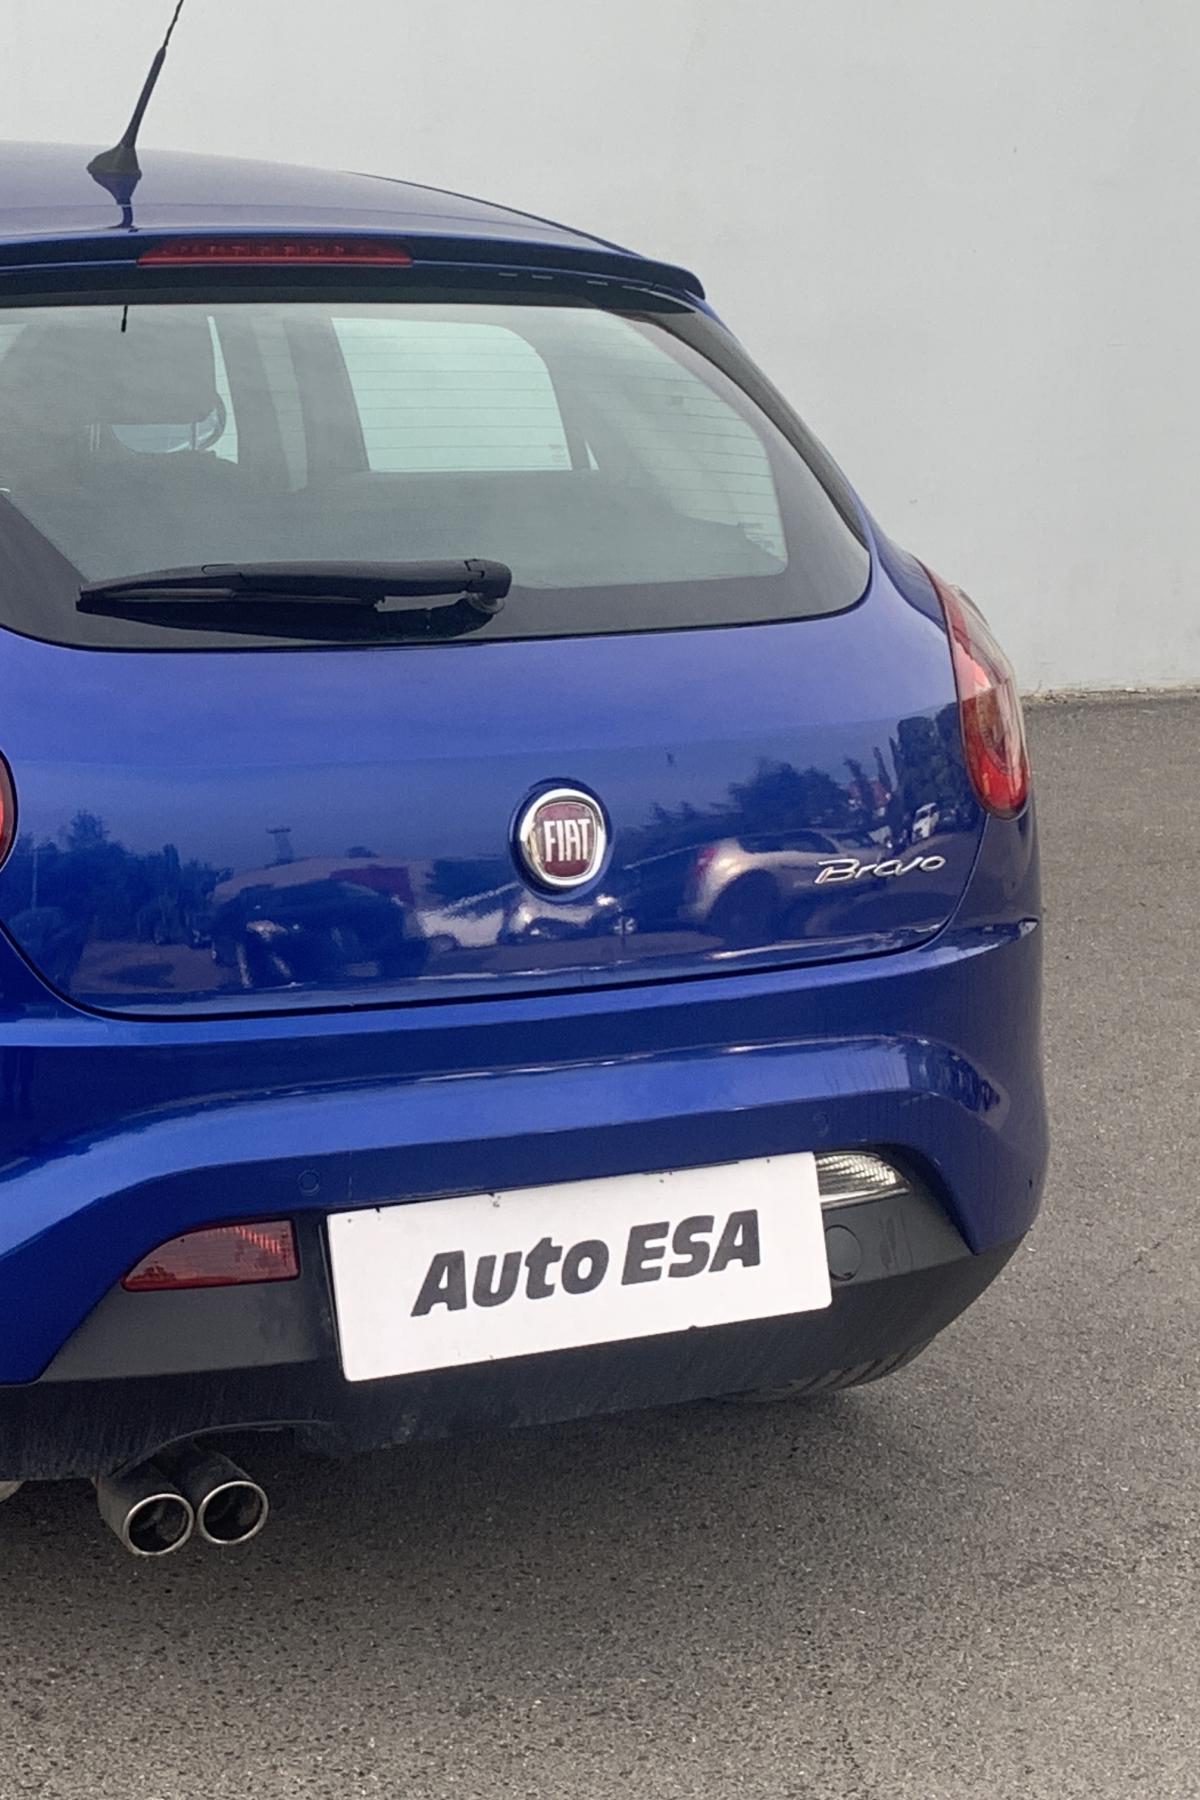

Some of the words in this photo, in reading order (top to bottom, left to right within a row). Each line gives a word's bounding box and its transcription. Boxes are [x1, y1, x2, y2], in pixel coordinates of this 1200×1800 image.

[543, 818, 591, 862] FIAT
[814, 855, 946, 885] Bravo
[410, 1237, 609, 1317] Auto
[621, 1209, 761, 1286] ESA
